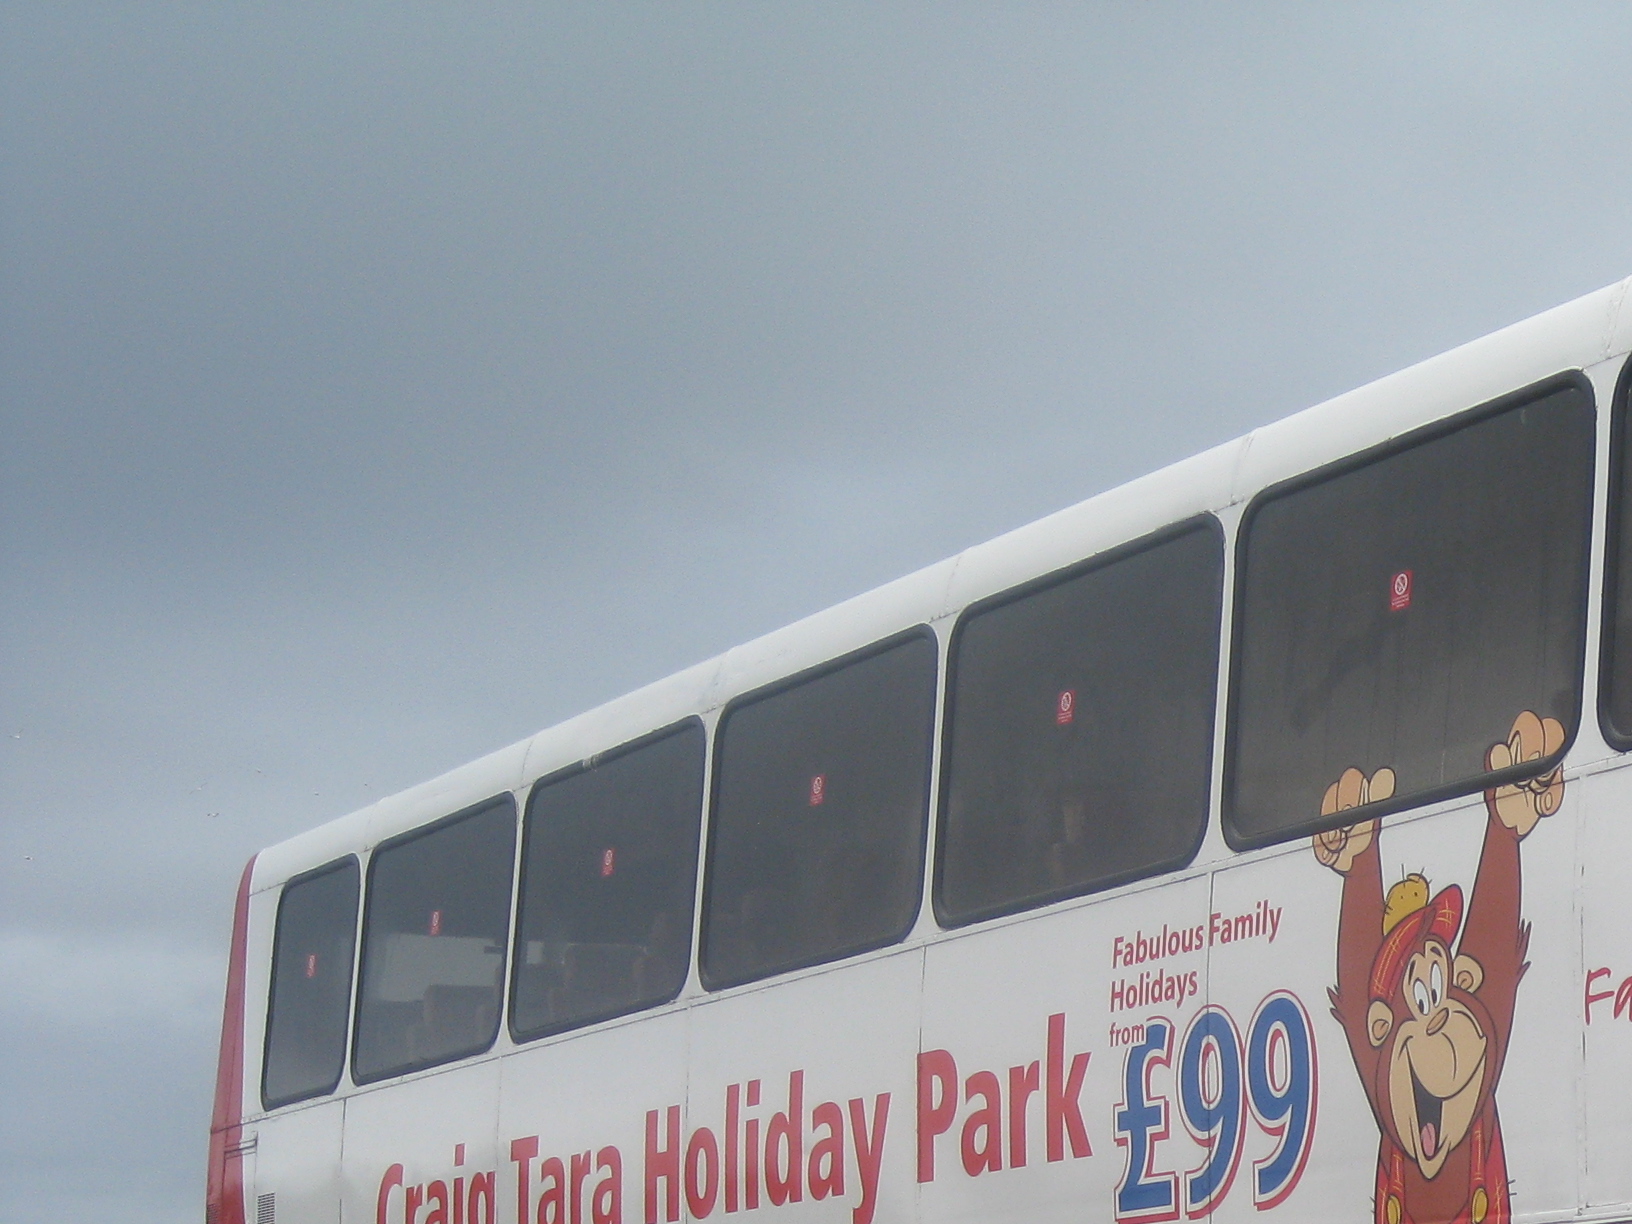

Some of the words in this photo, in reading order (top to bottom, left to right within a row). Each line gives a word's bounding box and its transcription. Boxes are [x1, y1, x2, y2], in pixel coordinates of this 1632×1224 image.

[1112, 925, 1204, 969] Fabulous
[1210, 899, 1283, 947] Family
[1110, 969, 1199, 1013] Holidays
[1110, 1021, 1145, 1048] from
[917, 1012, 1093, 1184] Park
